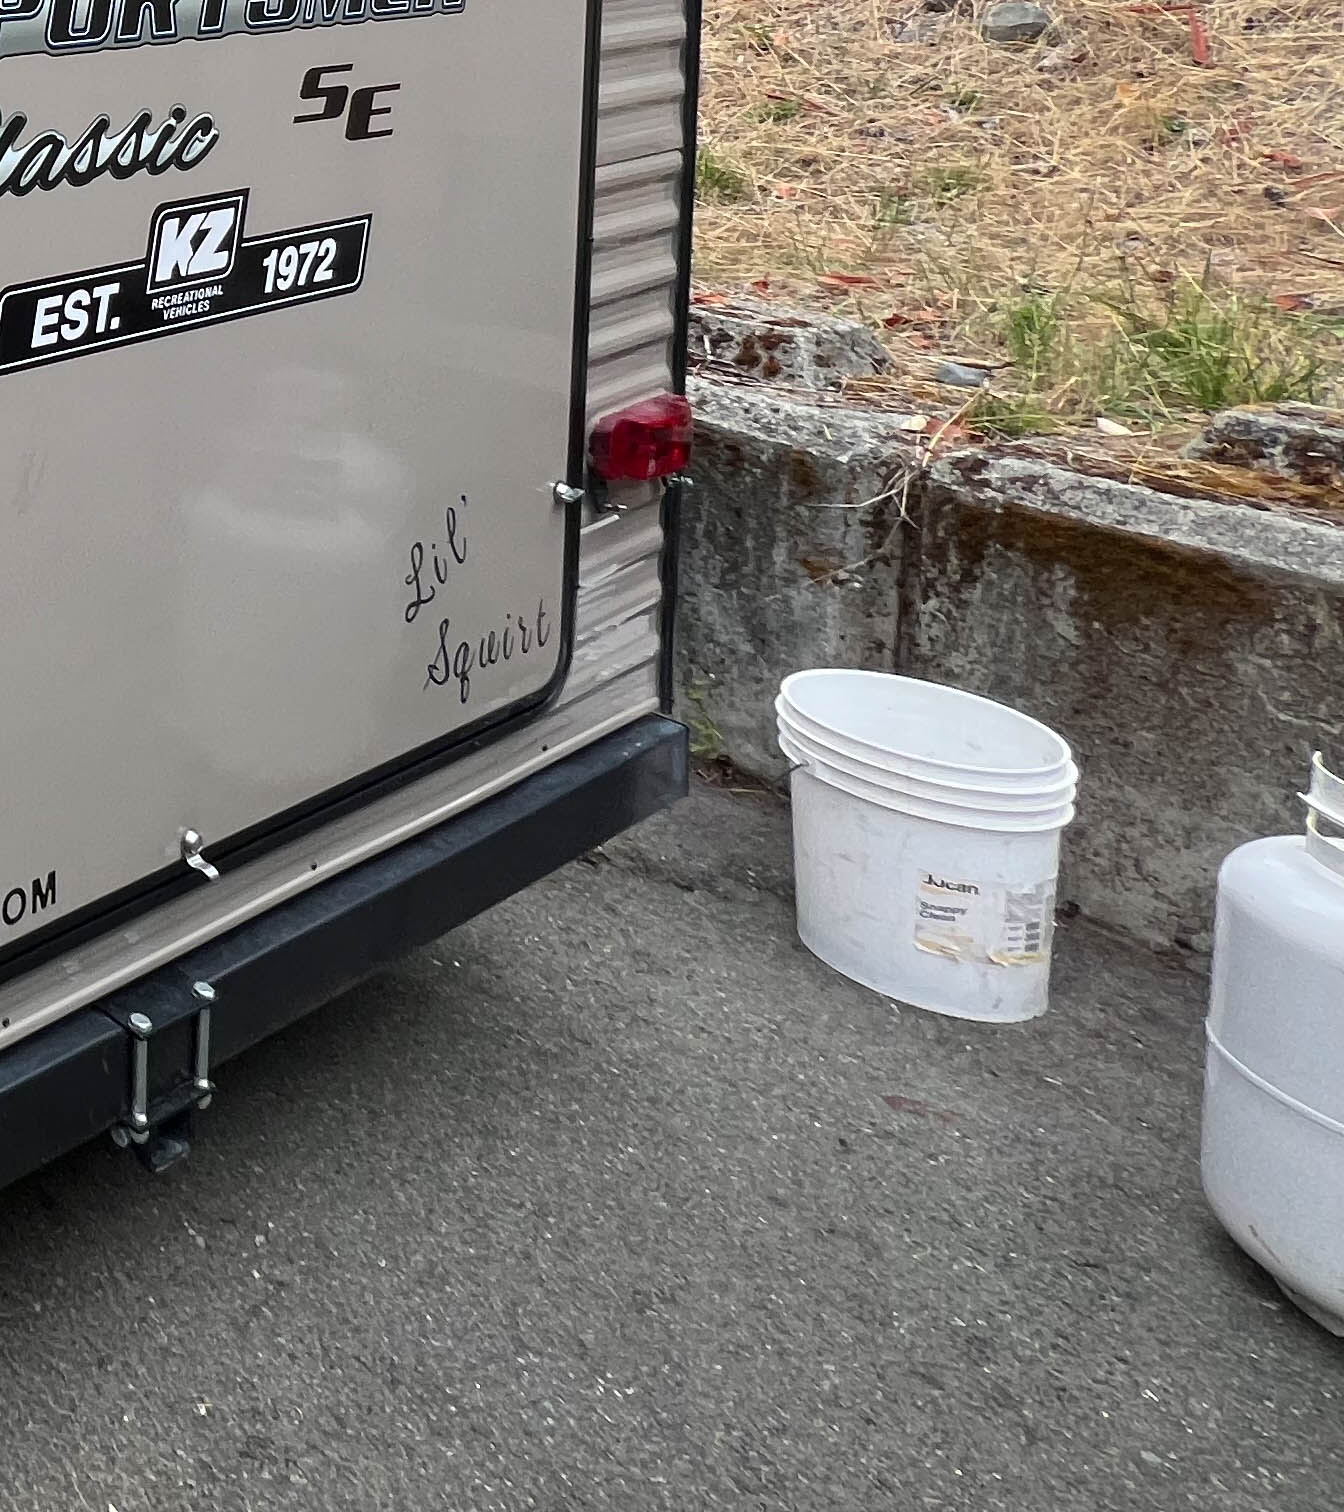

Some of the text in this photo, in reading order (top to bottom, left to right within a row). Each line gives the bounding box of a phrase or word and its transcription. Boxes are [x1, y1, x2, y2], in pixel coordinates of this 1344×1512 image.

[292, 63, 401, 141] SE
[154, 207, 236, 284] KZ
[30, 238, 337, 349] EST. 1972
[150, 284, 224, 311] RECREATIONAL
[162, 299, 211, 321] VEHICLES
[423, 598, 553, 704] Squirt
